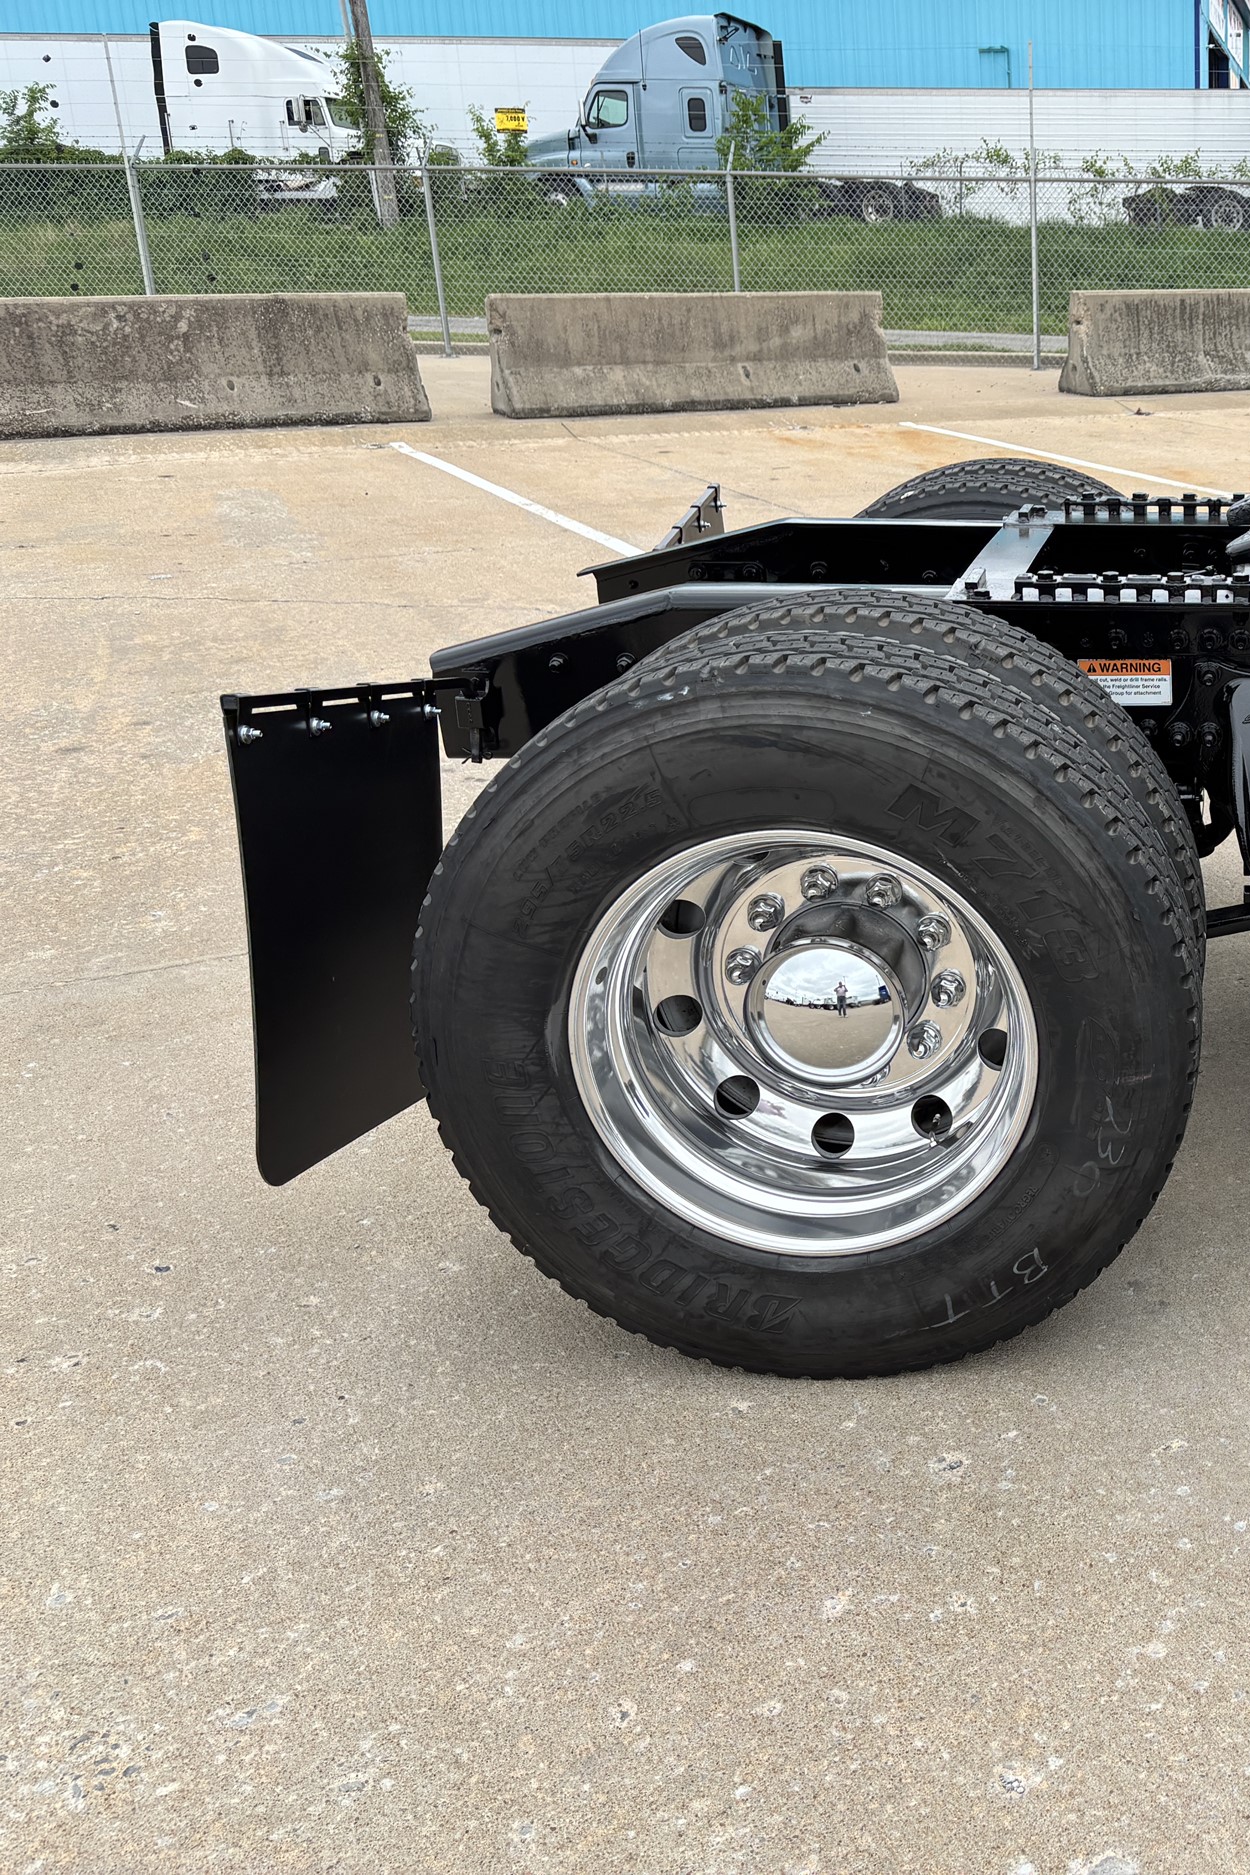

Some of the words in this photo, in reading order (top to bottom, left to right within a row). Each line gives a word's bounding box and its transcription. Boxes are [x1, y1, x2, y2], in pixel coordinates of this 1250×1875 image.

[1099, 662, 1161, 673] WARNING
[884, 784, 1099, 983] M713
[481, 1057, 803, 1335] BRIDGESTONE
